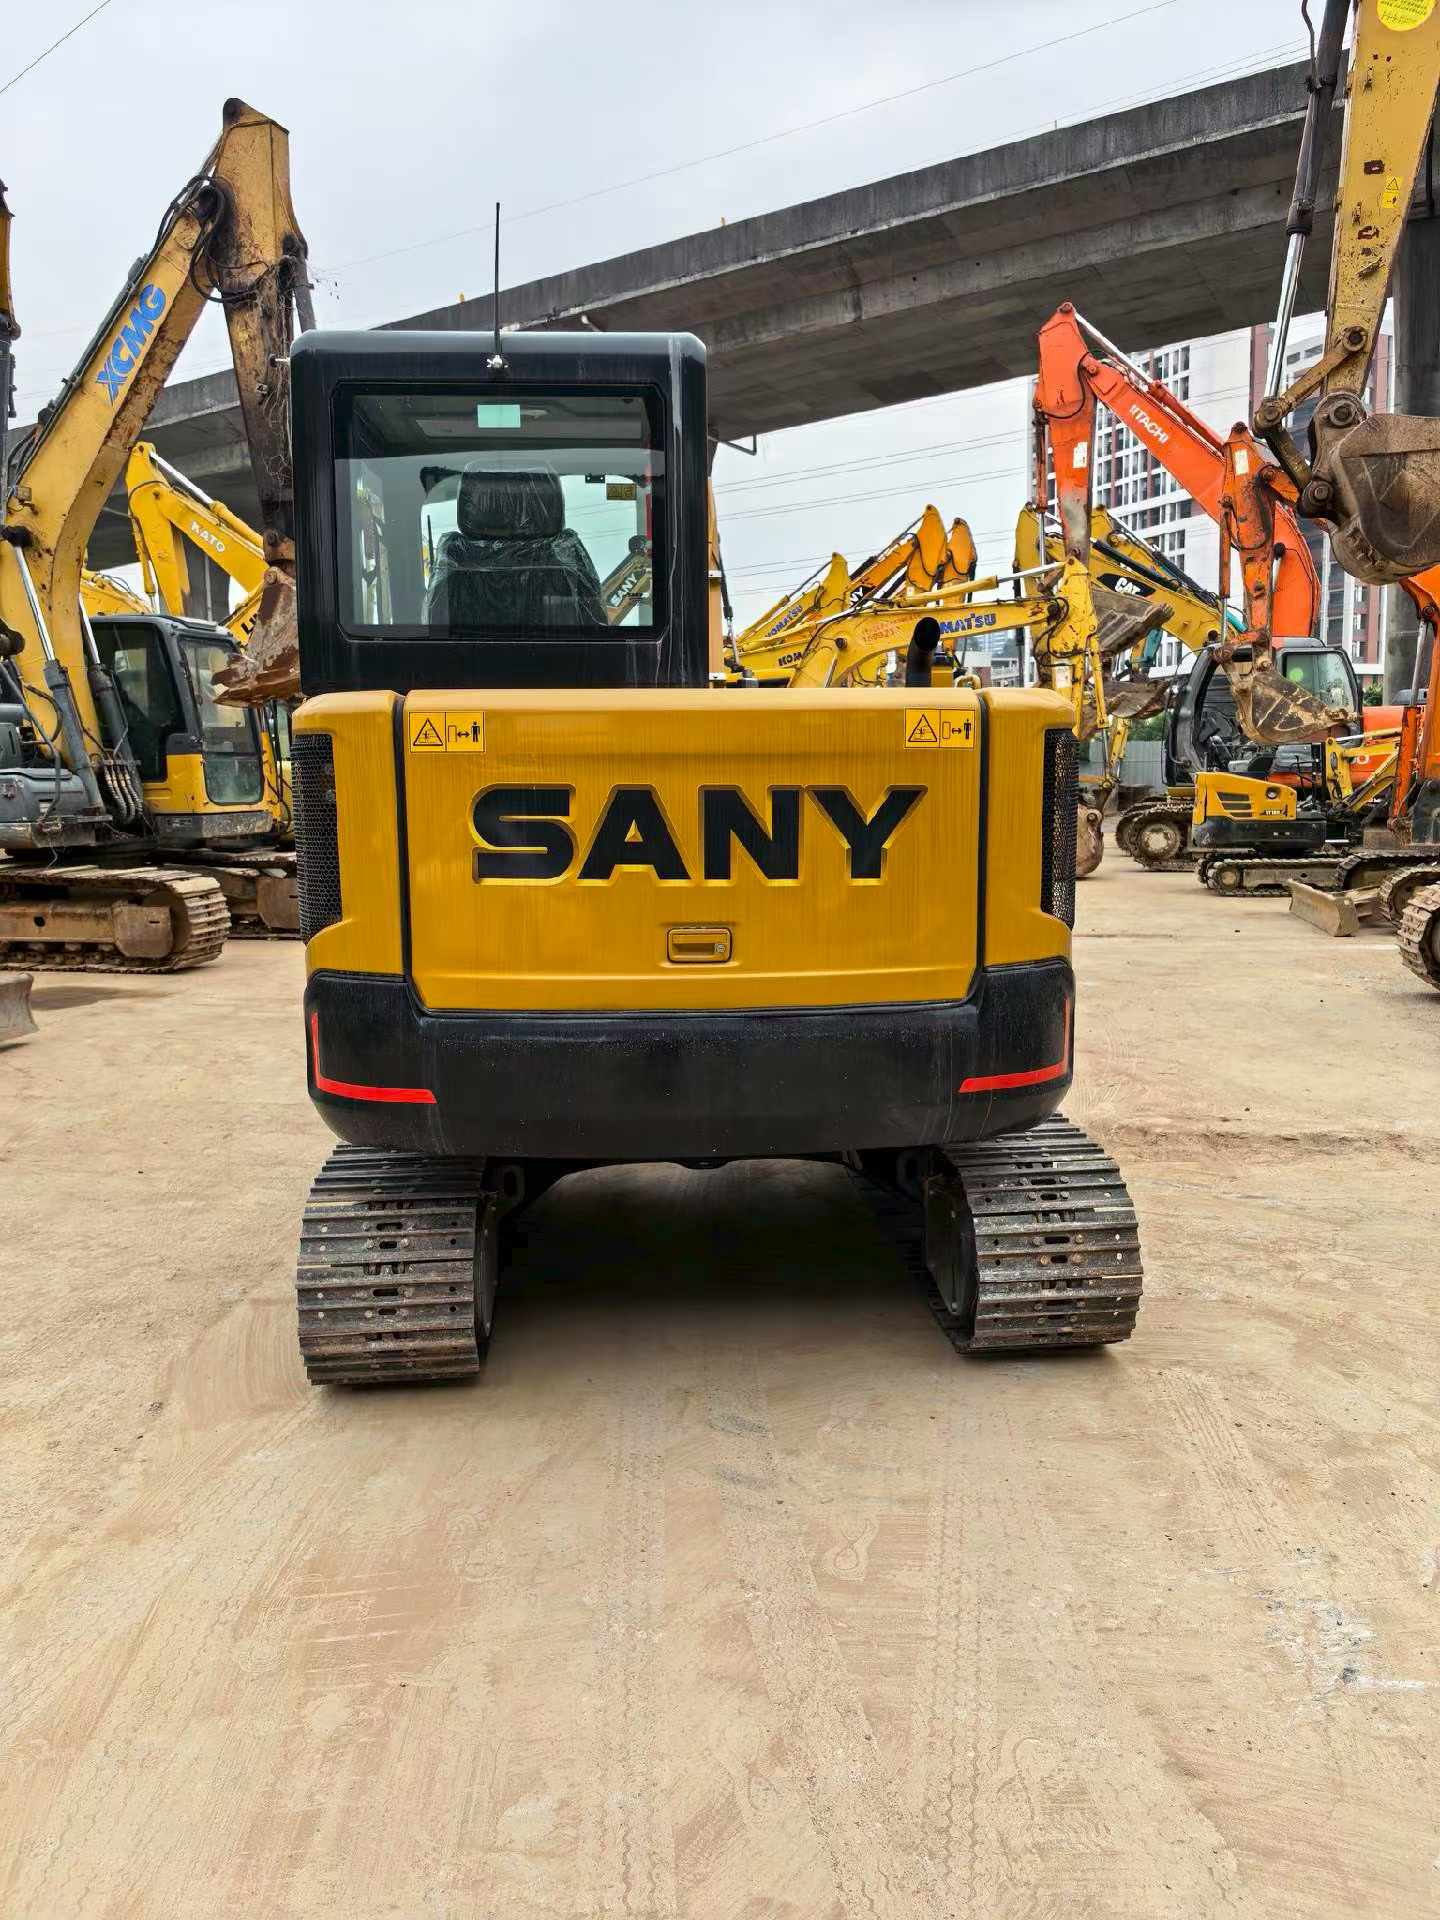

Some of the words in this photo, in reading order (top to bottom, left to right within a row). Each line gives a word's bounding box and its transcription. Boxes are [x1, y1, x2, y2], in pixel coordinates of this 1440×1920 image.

[96, 283, 166, 401] XCMG
[191, 520, 225, 552] KATO
[610, 572, 638, 607] SANY
[1114, 577, 1141, 595] CAT
[469, 783, 928, 886] SANY
